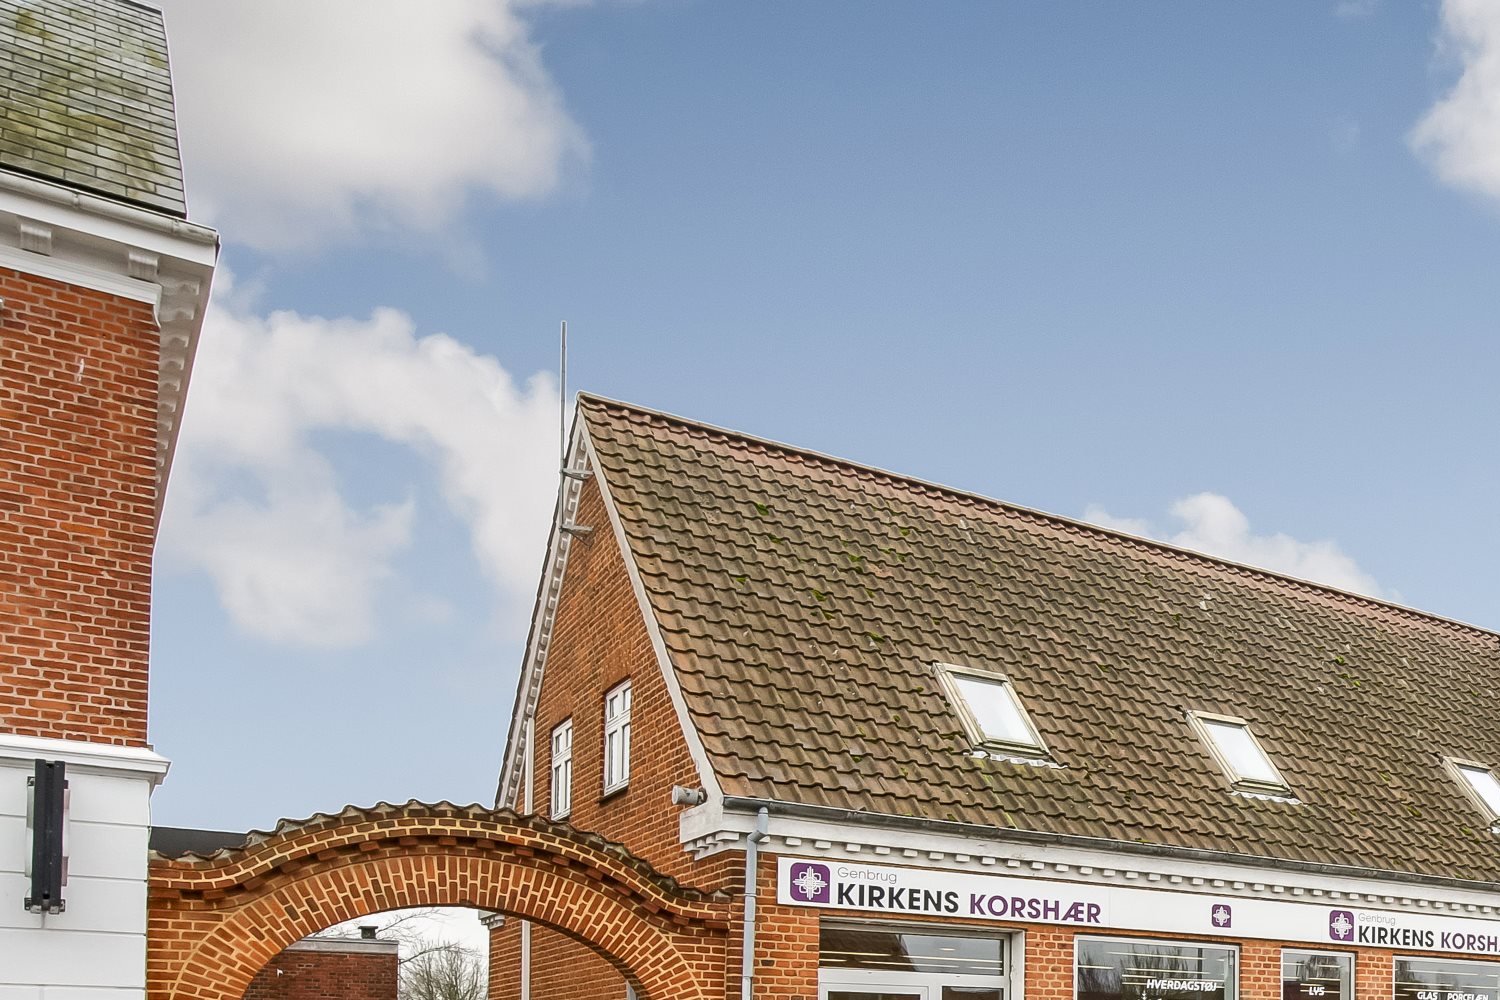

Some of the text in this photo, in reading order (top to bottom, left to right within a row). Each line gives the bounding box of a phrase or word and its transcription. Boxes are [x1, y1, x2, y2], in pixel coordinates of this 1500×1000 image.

[837, 866, 898, 884] Genbrug
[837, 882, 1102, 924] KIRKENS KORSHÆR
[1358, 912, 1396, 926] Genbrug
[1358, 925, 1434, 948] KIRKENS
[1146, 979, 1217, 992] HVERDAGSTØJ
[1308, 986, 1325, 996] LYS
[1416, 991, 1439, 1000] GLAS
